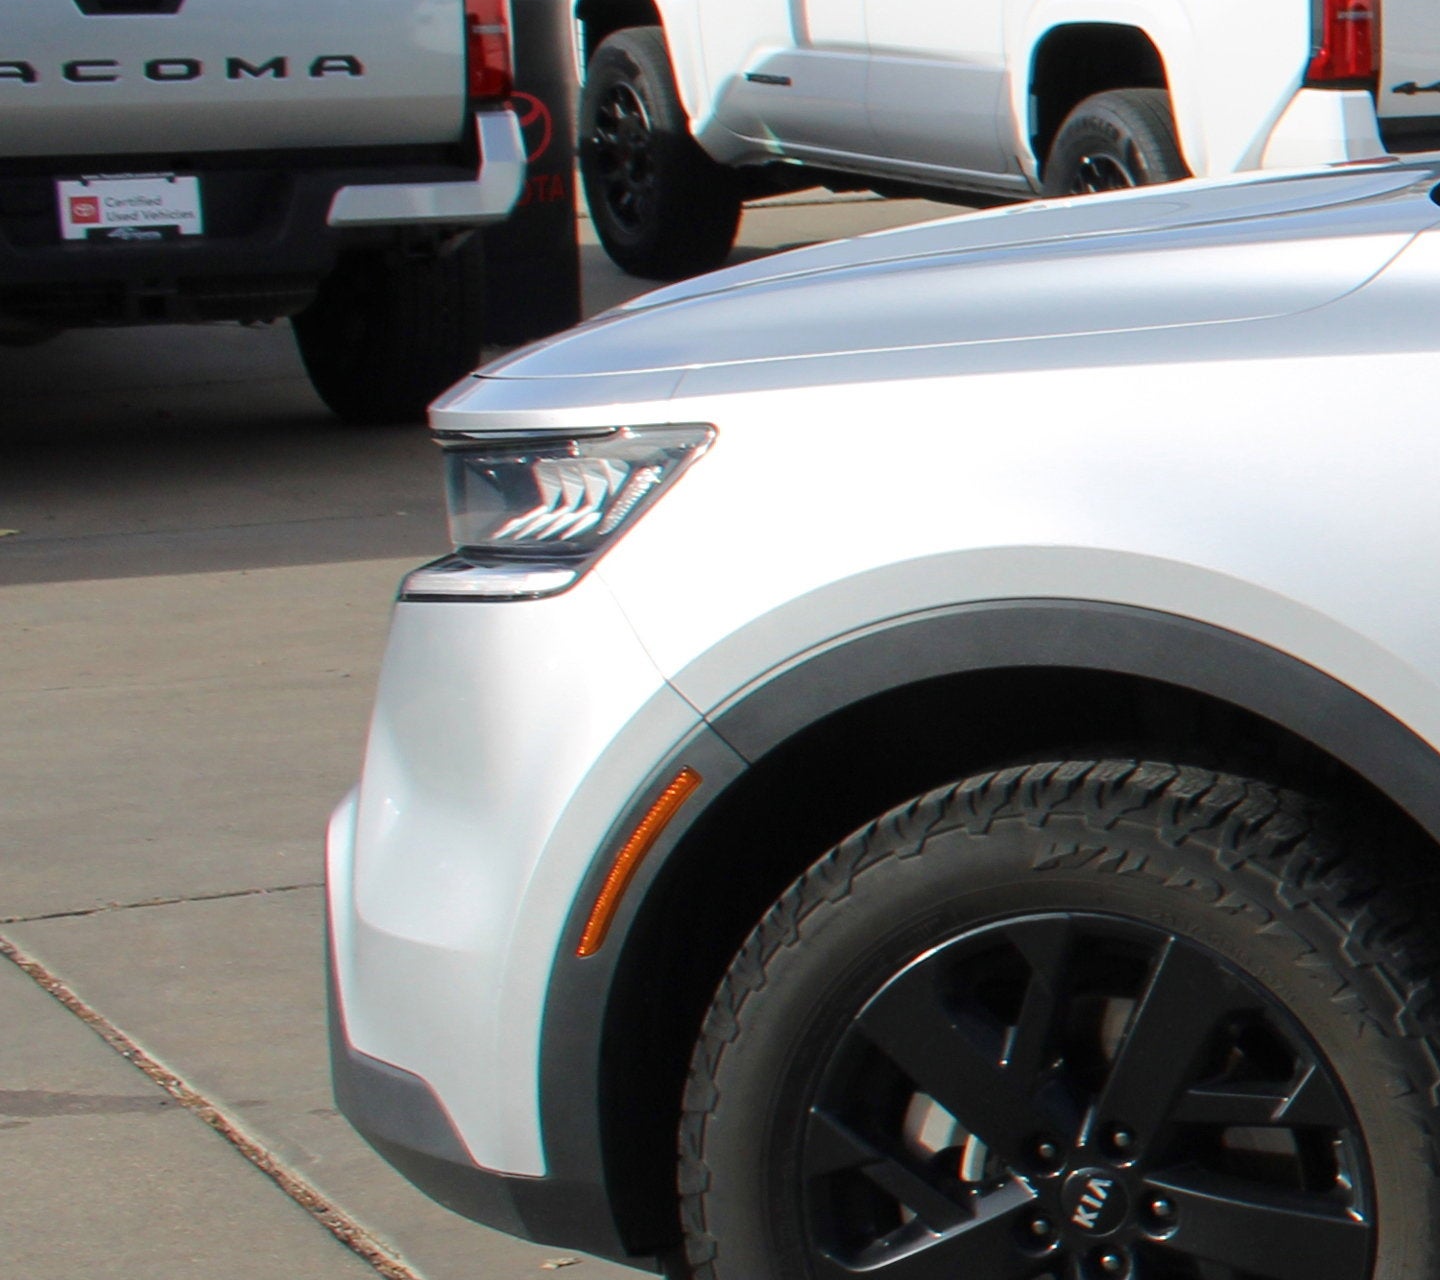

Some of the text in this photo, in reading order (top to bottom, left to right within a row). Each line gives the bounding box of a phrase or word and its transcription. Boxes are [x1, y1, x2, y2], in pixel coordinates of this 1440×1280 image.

[104, 195, 162, 208] Certified
[105, 208, 195, 222] Used Vehicles
[1072, 1178, 1112, 1229] KIA
